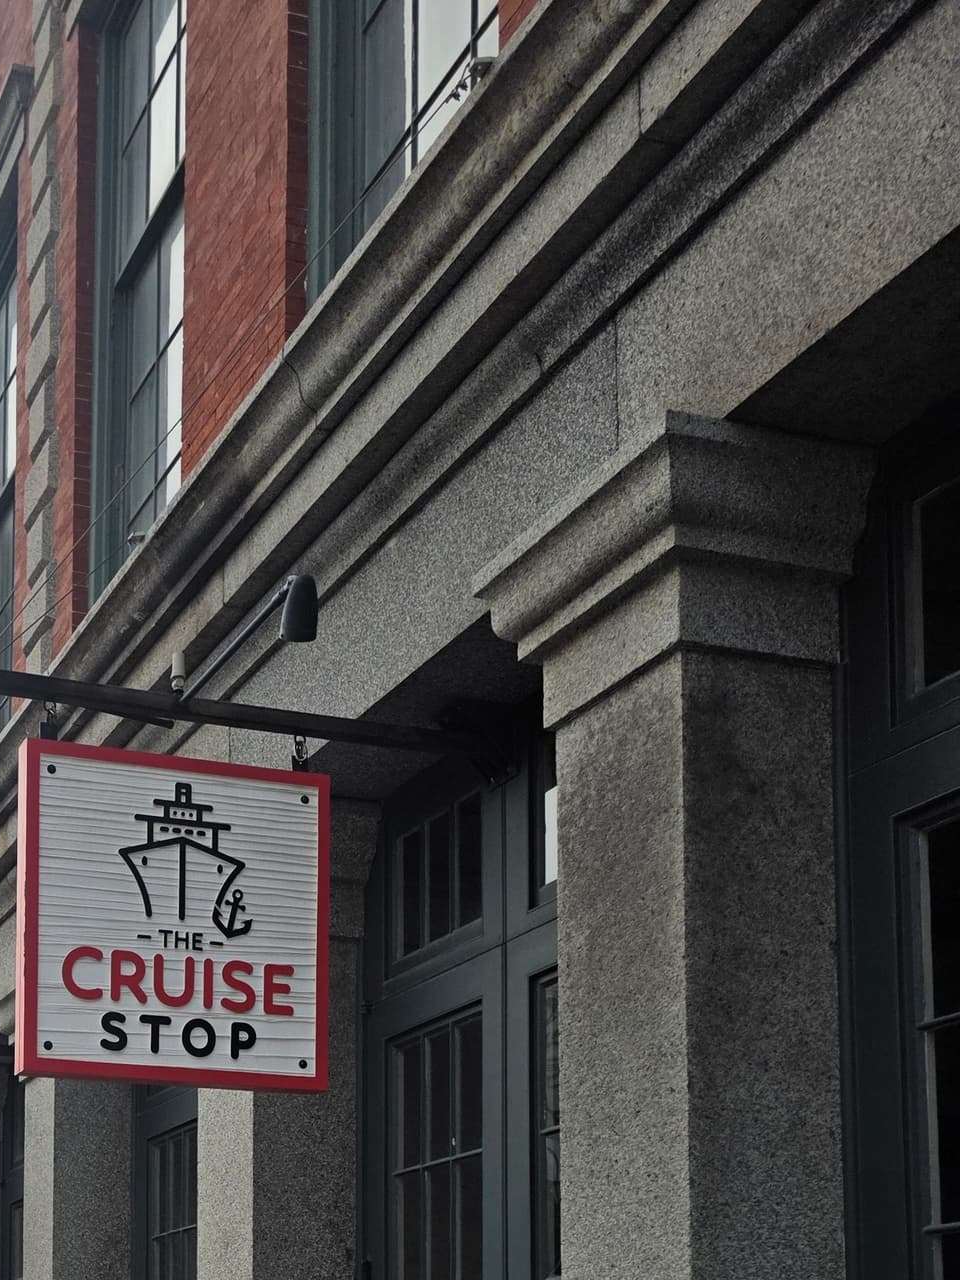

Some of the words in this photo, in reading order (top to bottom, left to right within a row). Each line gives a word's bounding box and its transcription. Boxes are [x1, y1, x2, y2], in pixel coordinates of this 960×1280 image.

[158, 929, 204, 951] THE
[61, 945, 295, 1017] CRUISE
[100, 1011, 257, 1060] STOP
